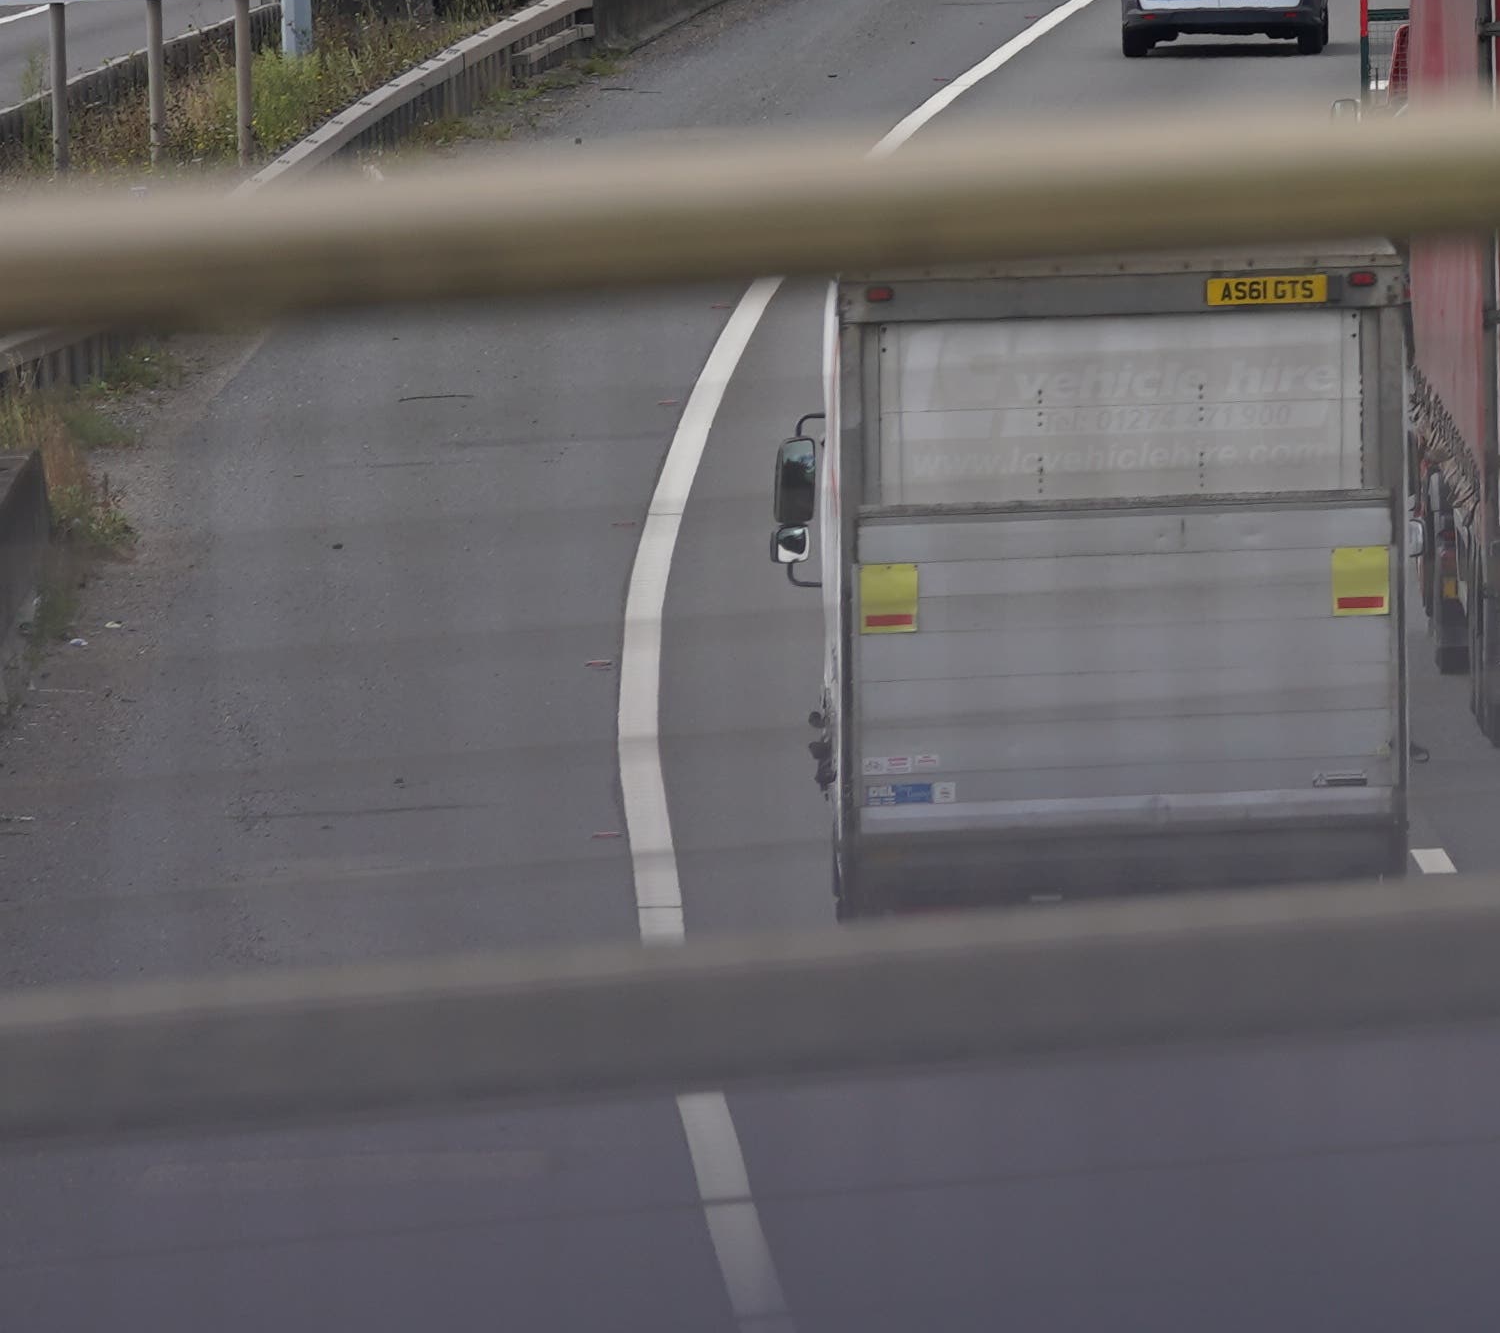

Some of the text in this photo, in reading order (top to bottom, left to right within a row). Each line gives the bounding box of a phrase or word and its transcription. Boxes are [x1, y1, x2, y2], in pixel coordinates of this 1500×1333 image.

[1220, 279, 1315, 302] AS61 GTS
[1013, 356, 1342, 401] vehicle hire
[1243, 404, 1292, 427] 900
